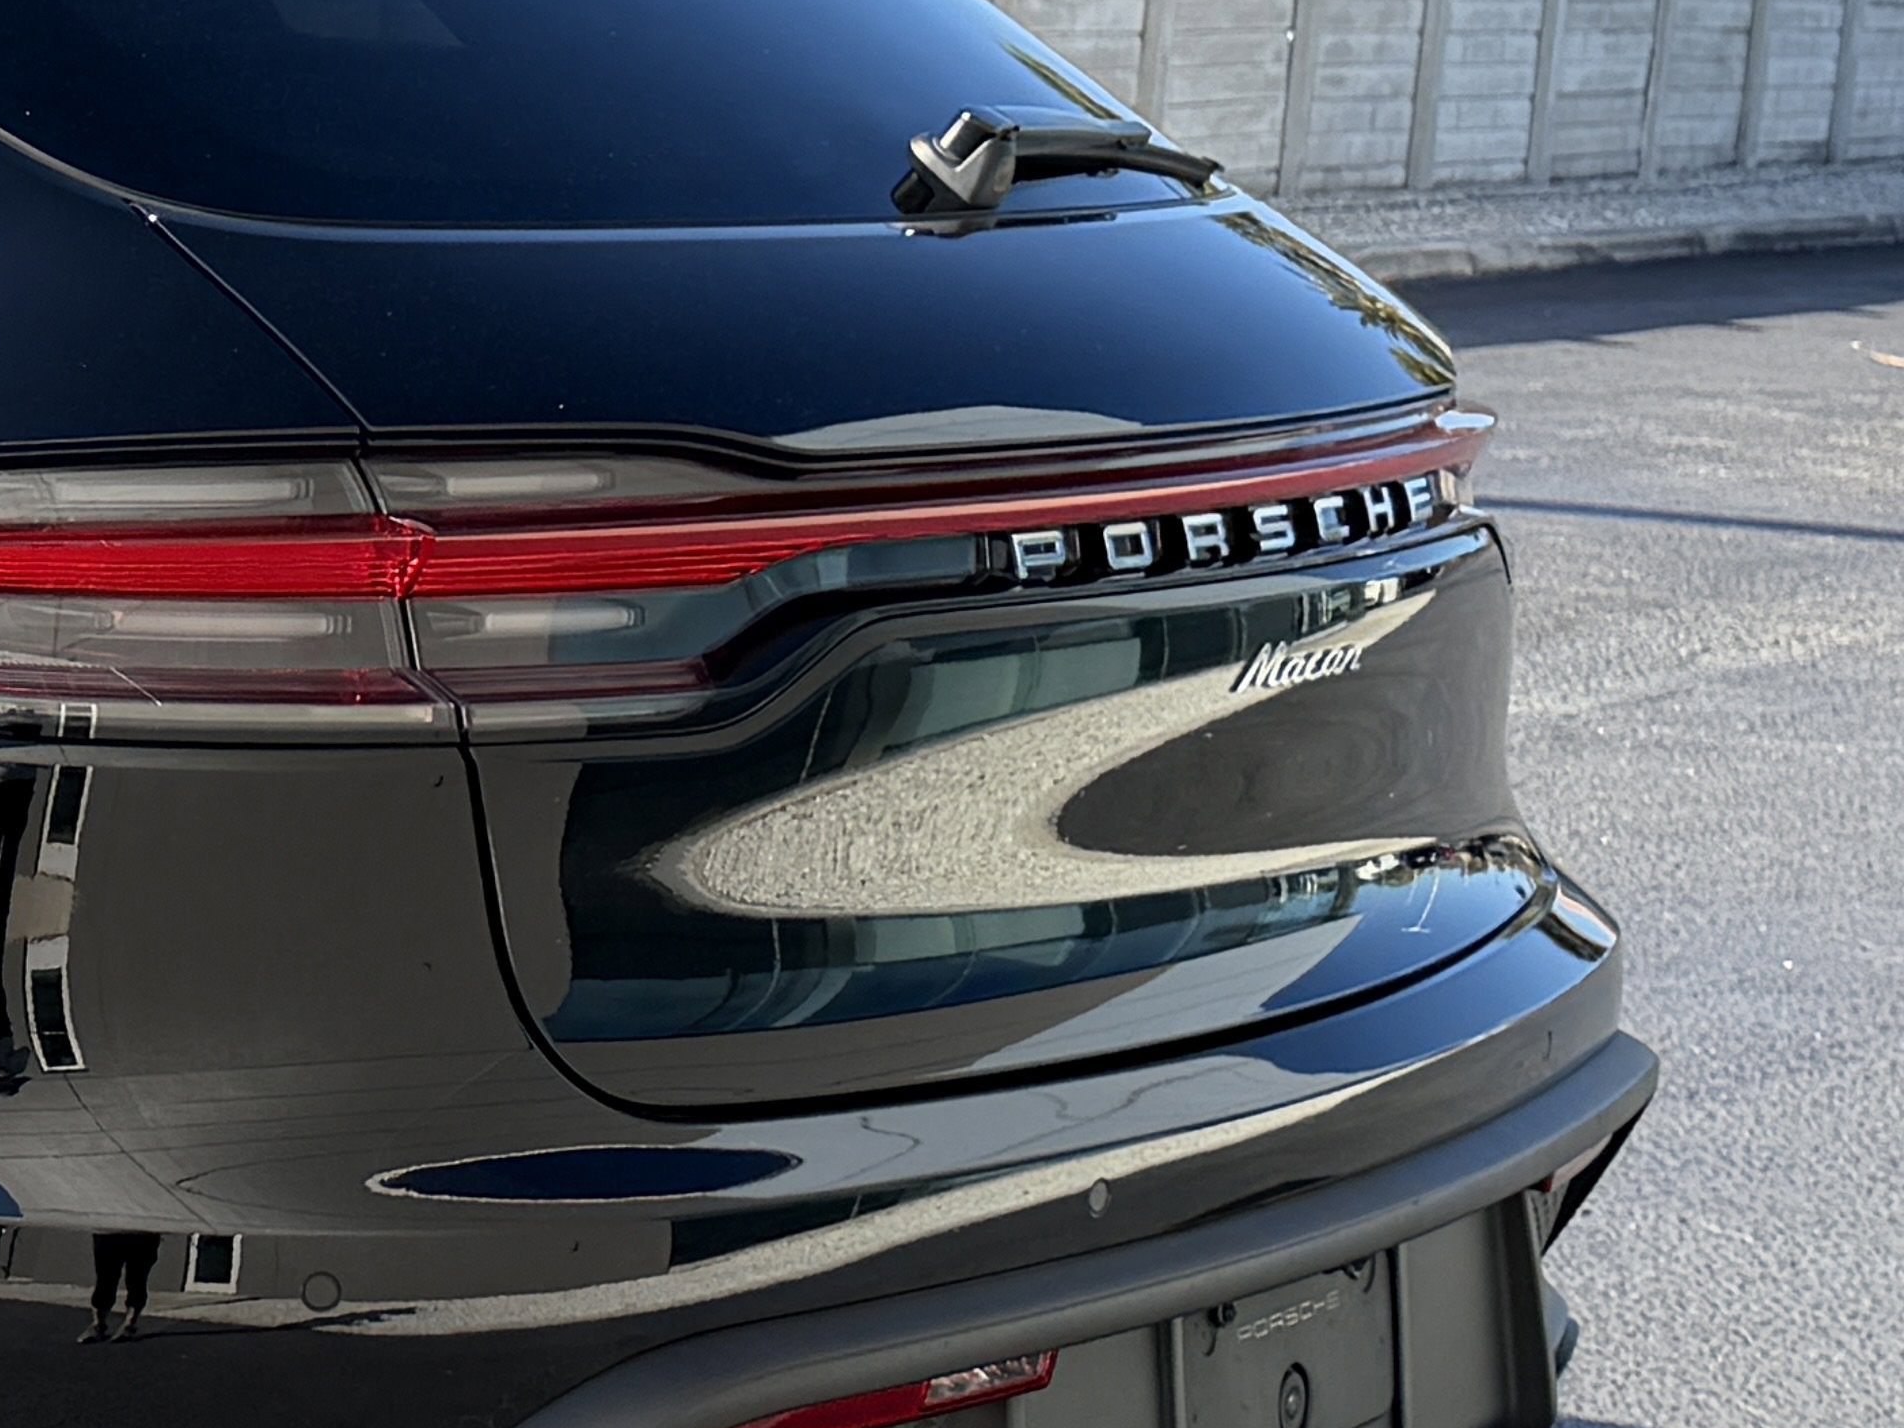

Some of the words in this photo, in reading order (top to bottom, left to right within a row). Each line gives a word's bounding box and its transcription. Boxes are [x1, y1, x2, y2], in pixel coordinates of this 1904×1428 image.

[1010, 477, 1434, 580] PORSCHE
[1235, 642, 1362, 694] Macan
[1236, 1289, 1342, 1343] PORSCHE
